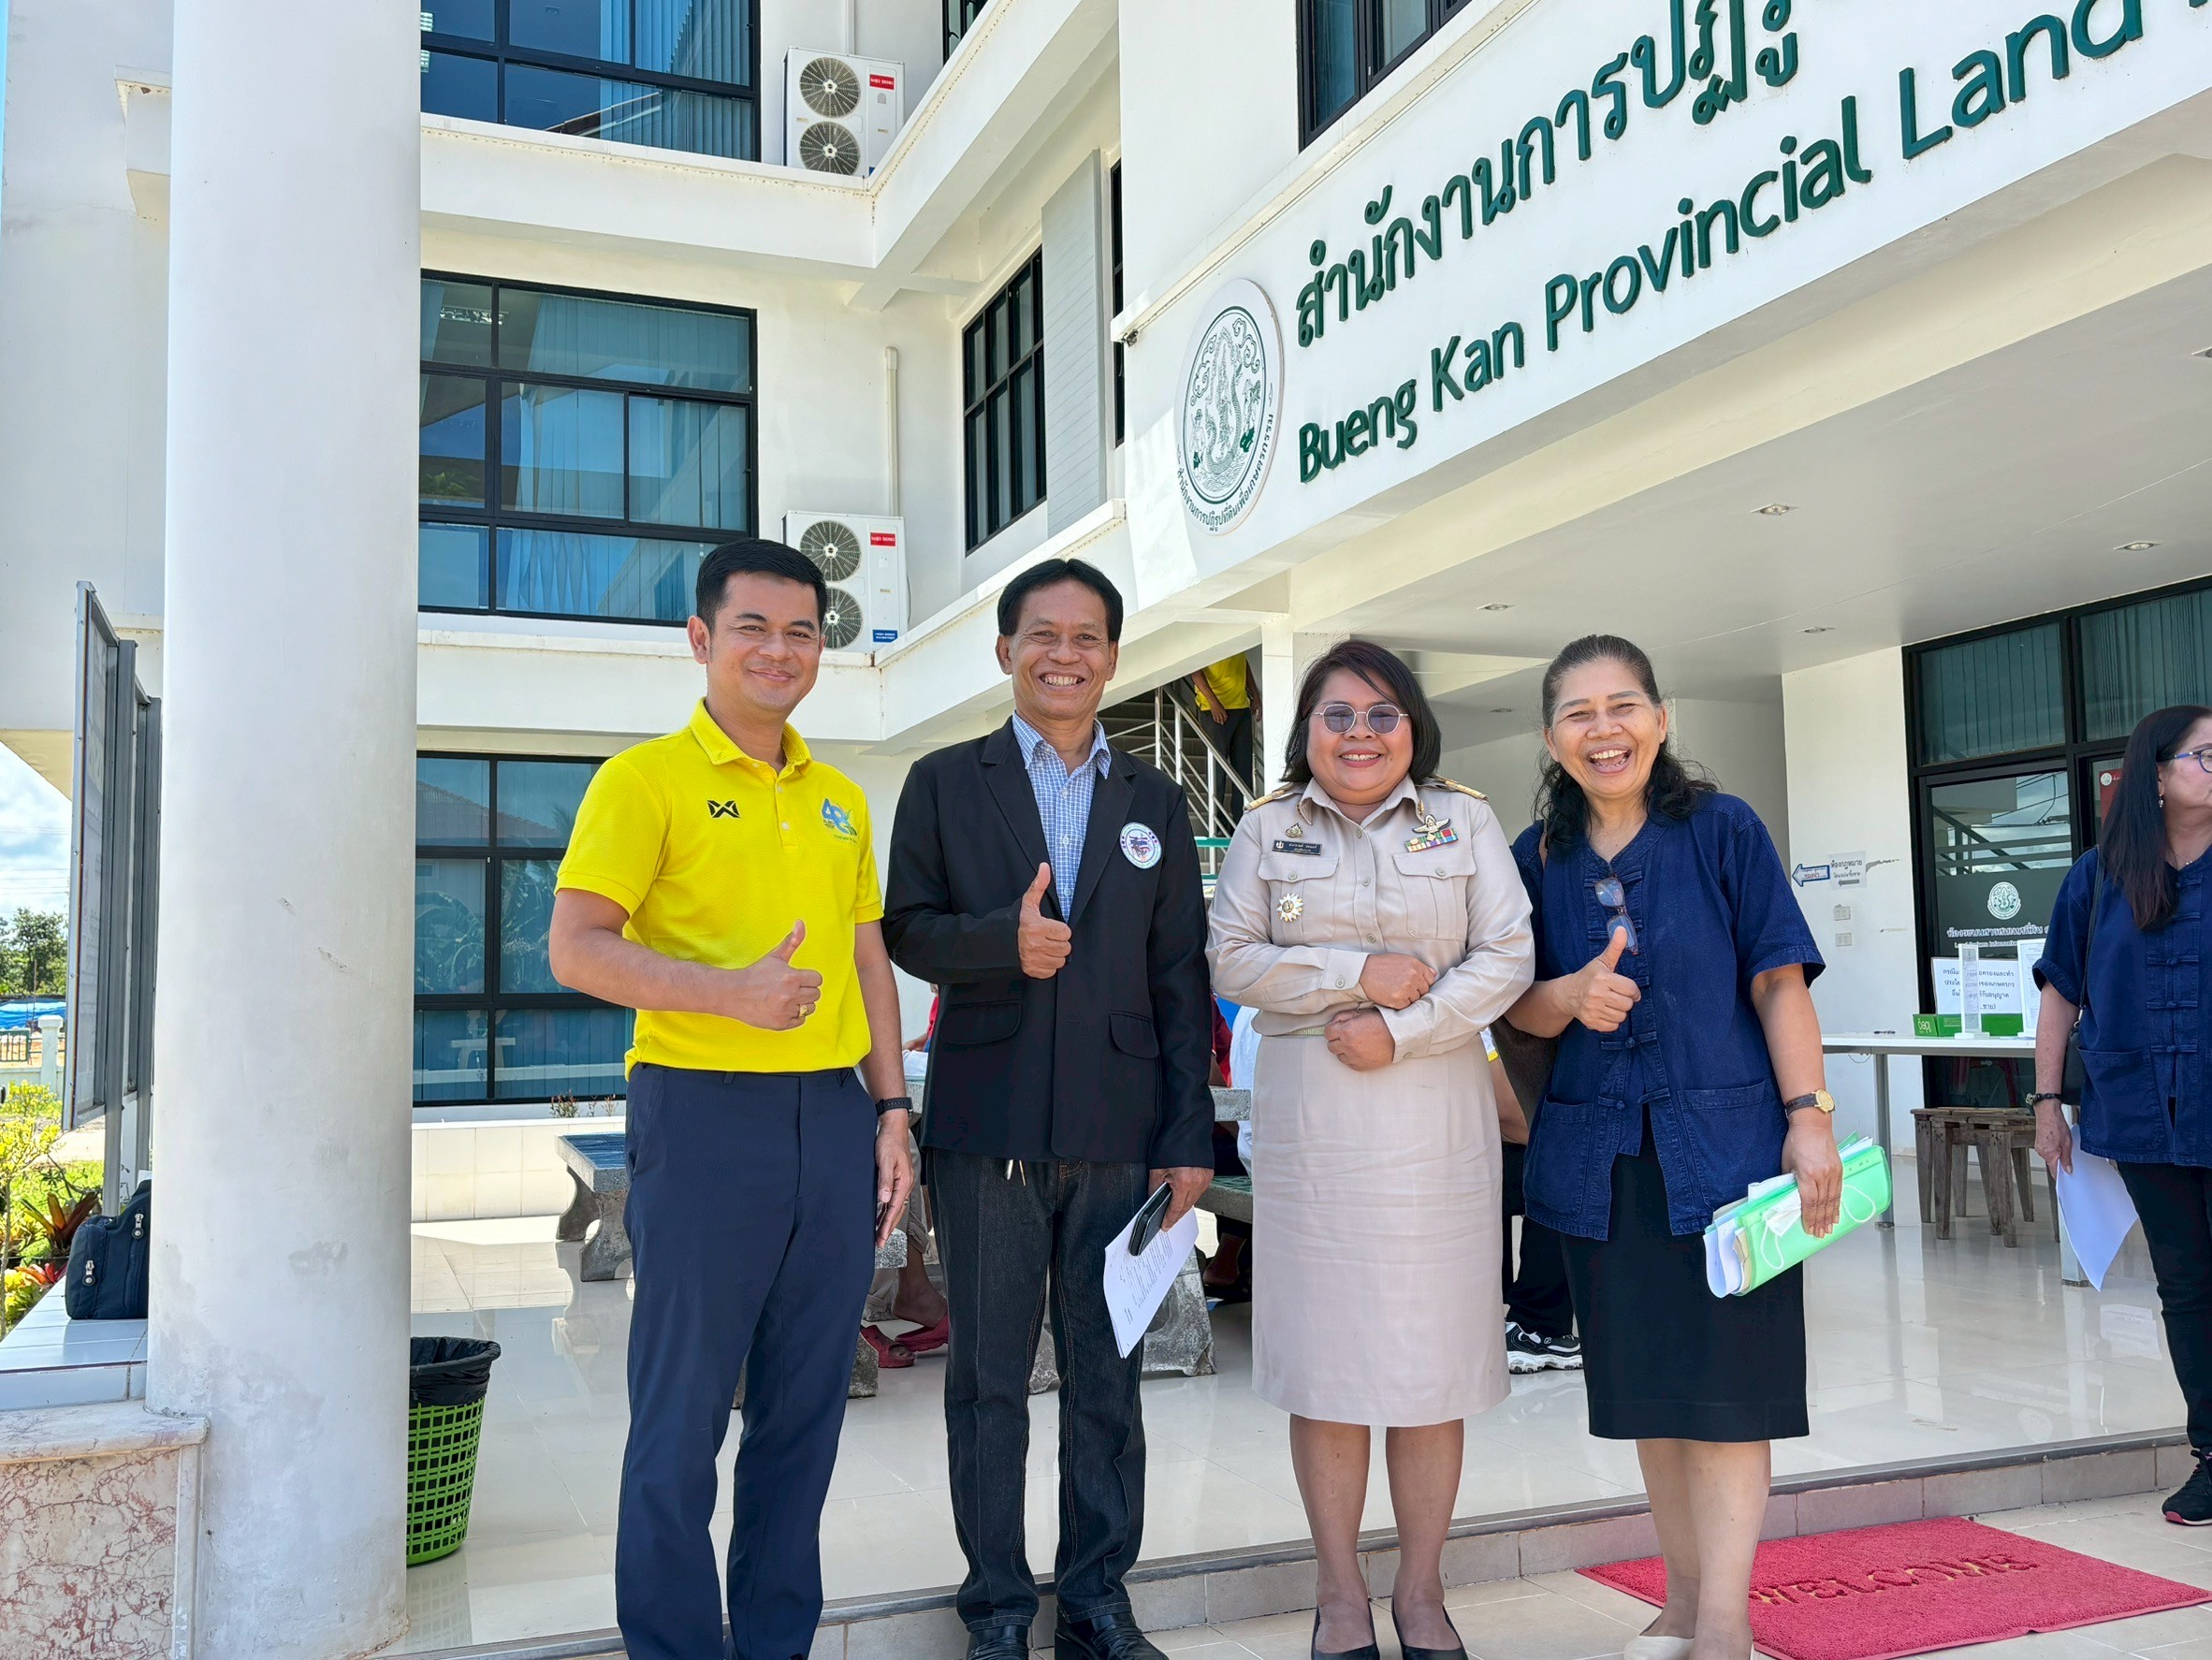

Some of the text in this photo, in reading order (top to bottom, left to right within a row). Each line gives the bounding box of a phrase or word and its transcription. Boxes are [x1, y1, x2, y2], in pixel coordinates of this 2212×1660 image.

[1299, 379, 1418, 484] Bueng
[1432, 321, 1525, 412] Kan
[1545, 96, 1872, 352] Provincial
[1748, 1552, 2041, 1605] WELCOME
